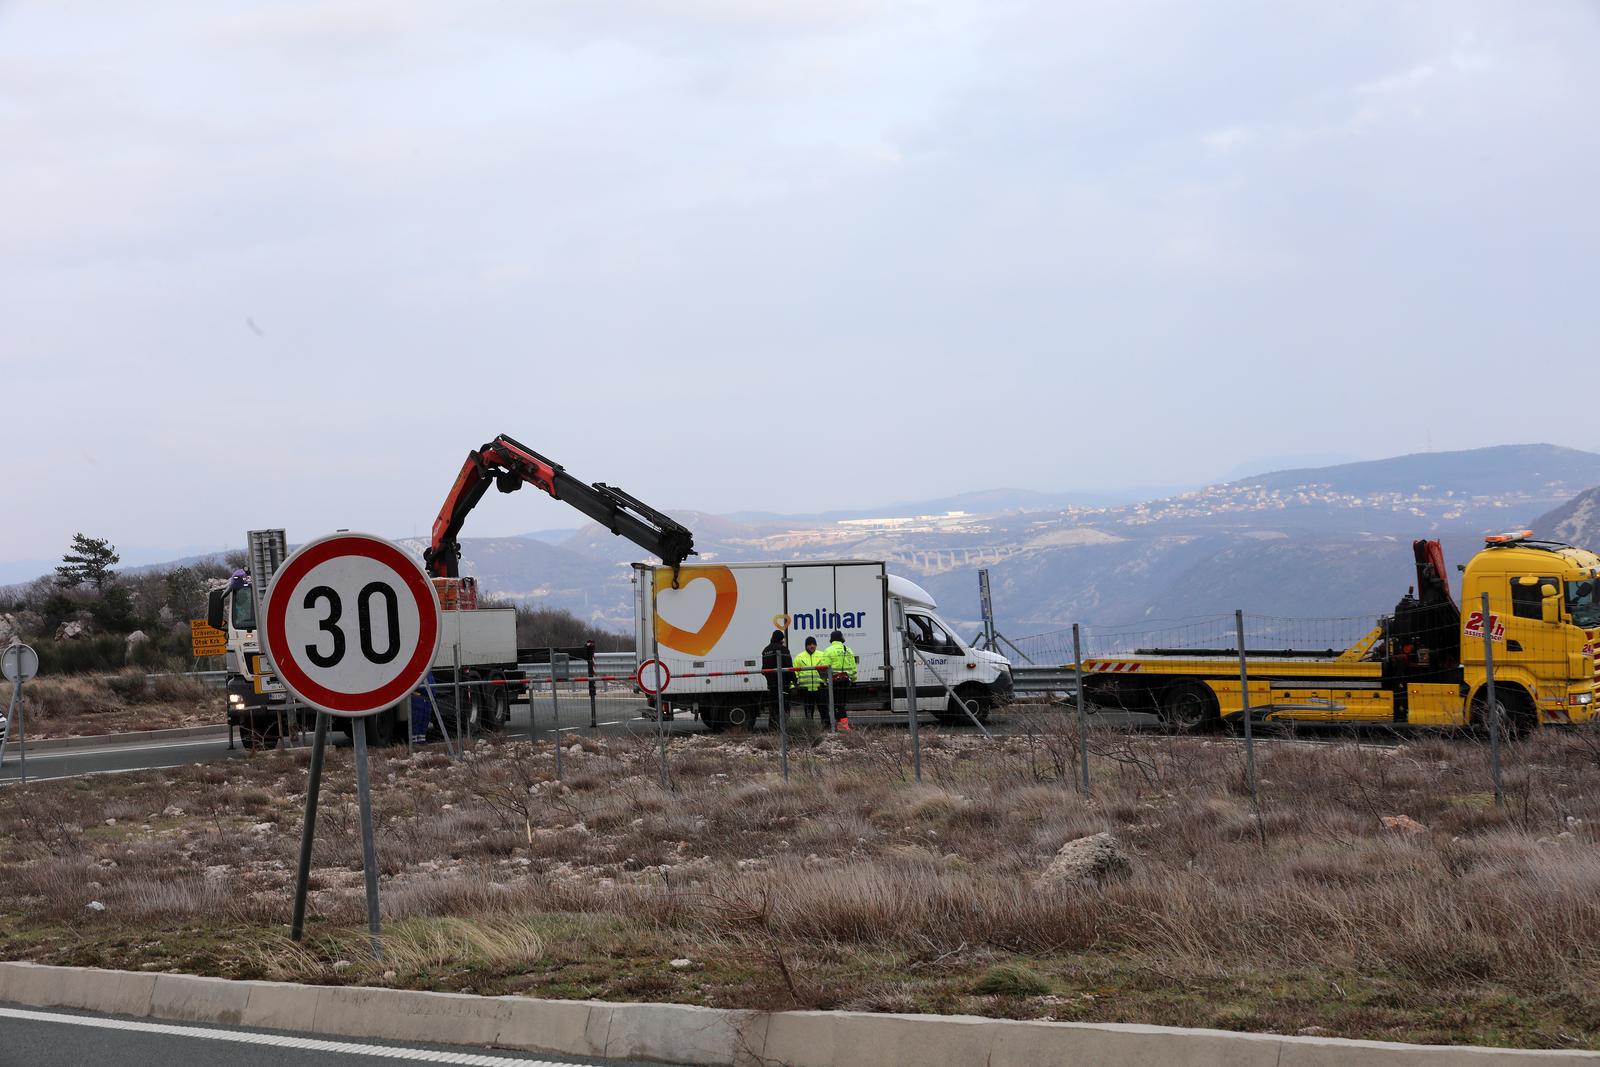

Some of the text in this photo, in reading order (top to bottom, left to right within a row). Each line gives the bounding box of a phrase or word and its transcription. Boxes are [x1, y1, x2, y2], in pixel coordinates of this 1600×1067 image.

[303, 580, 401, 669] 30
[793, 607, 866, 631] mlinar
[1465, 612, 1505, 636] 24h
[1464, 630, 1502, 641] assistnce
